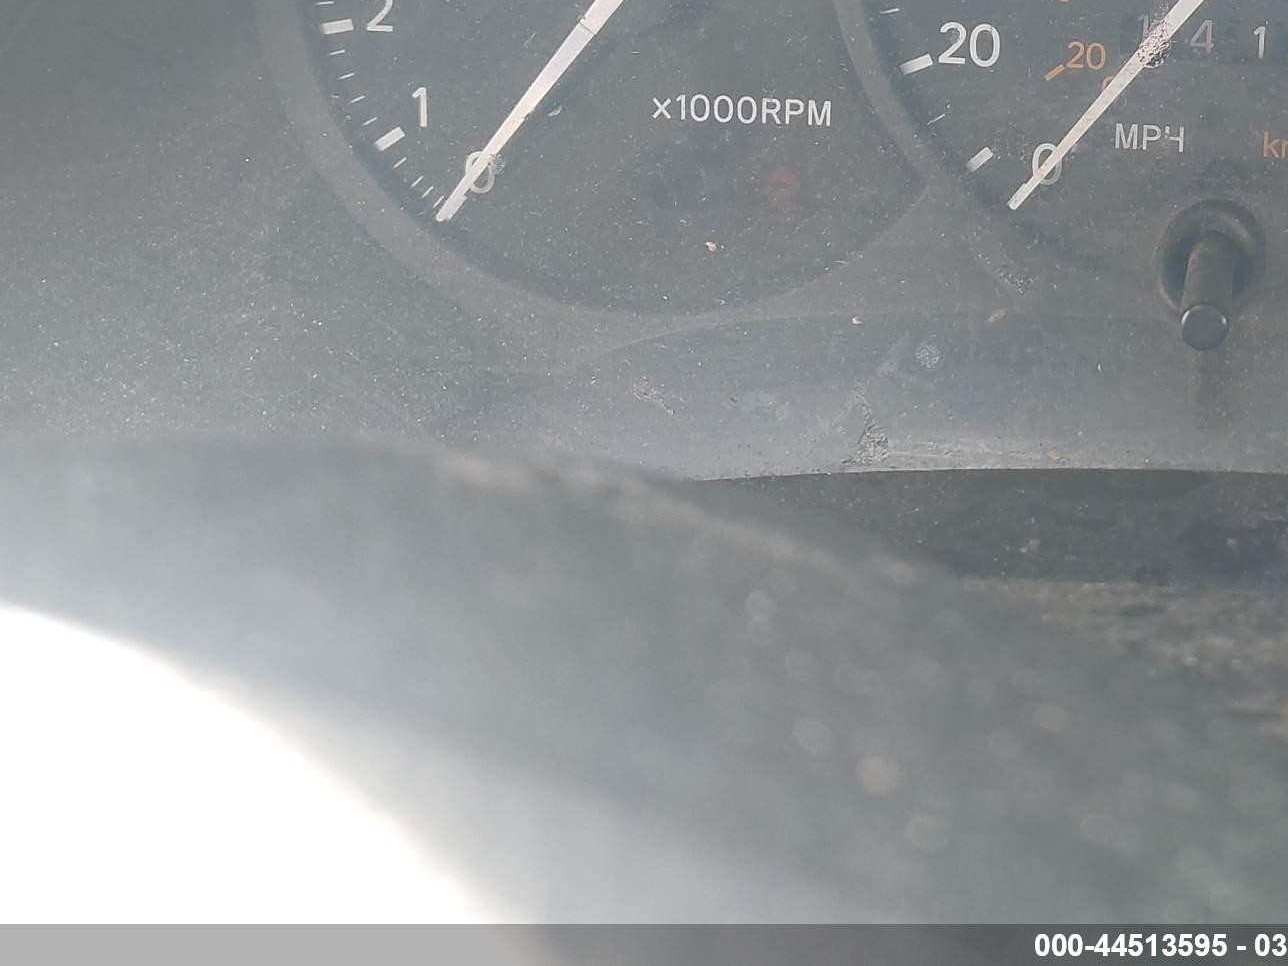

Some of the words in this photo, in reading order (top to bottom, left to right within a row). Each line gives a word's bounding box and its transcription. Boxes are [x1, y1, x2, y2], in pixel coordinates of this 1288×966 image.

[938, 22, 1000, 67] 20
[1067, 41, 1106, 70] 20
[412, 87, 428, 127] 1
[1114, 123, 1185, 153] MPH
[1032, 143, 1063, 185] 0
